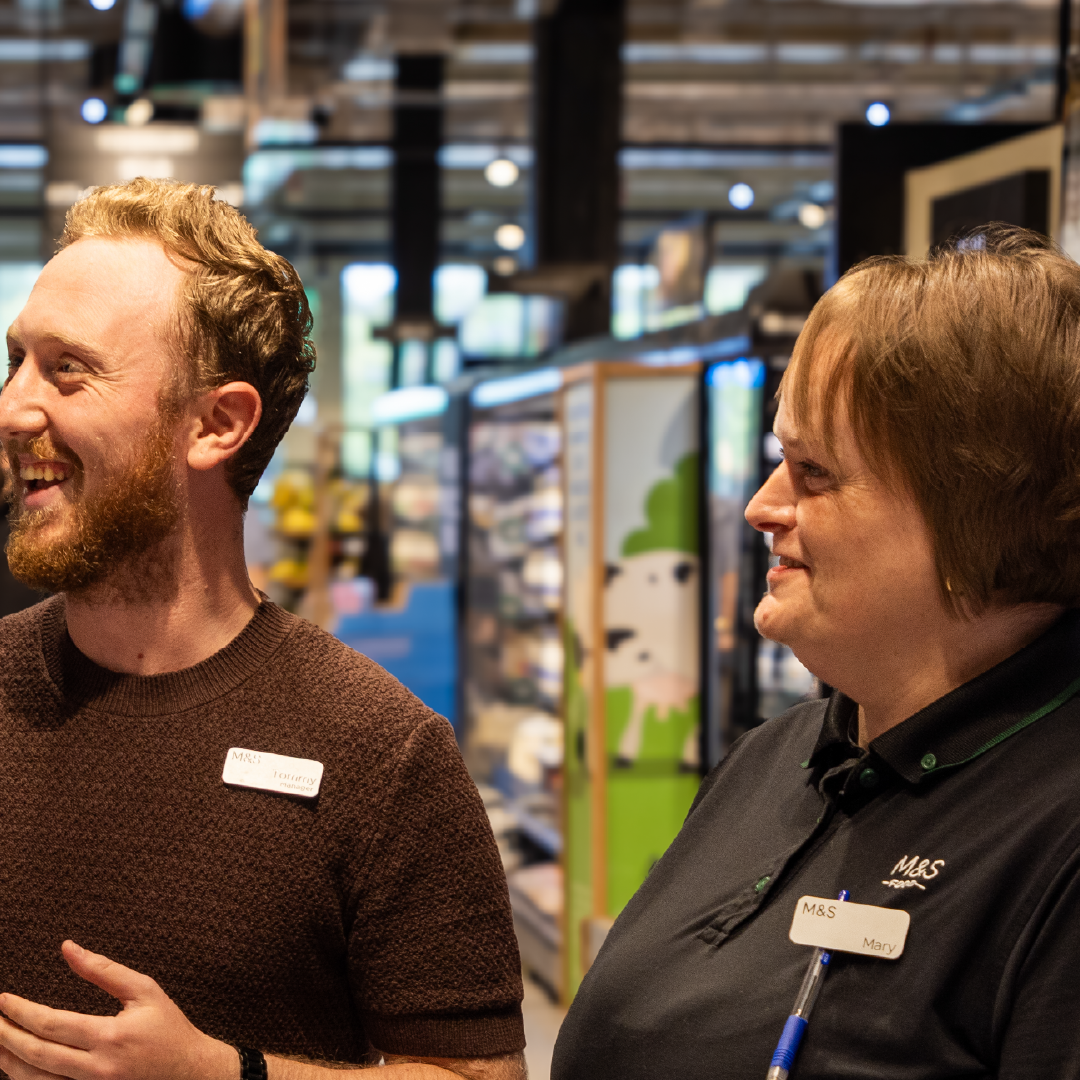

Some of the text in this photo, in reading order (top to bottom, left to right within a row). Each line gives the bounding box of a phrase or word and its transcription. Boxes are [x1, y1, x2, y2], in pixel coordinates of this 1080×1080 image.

[232, 751, 261, 764] M&S
[890, 855, 945, 879] M&S
[802, 902, 837, 919] M&S
[862, 937, 897, 955] Mary
